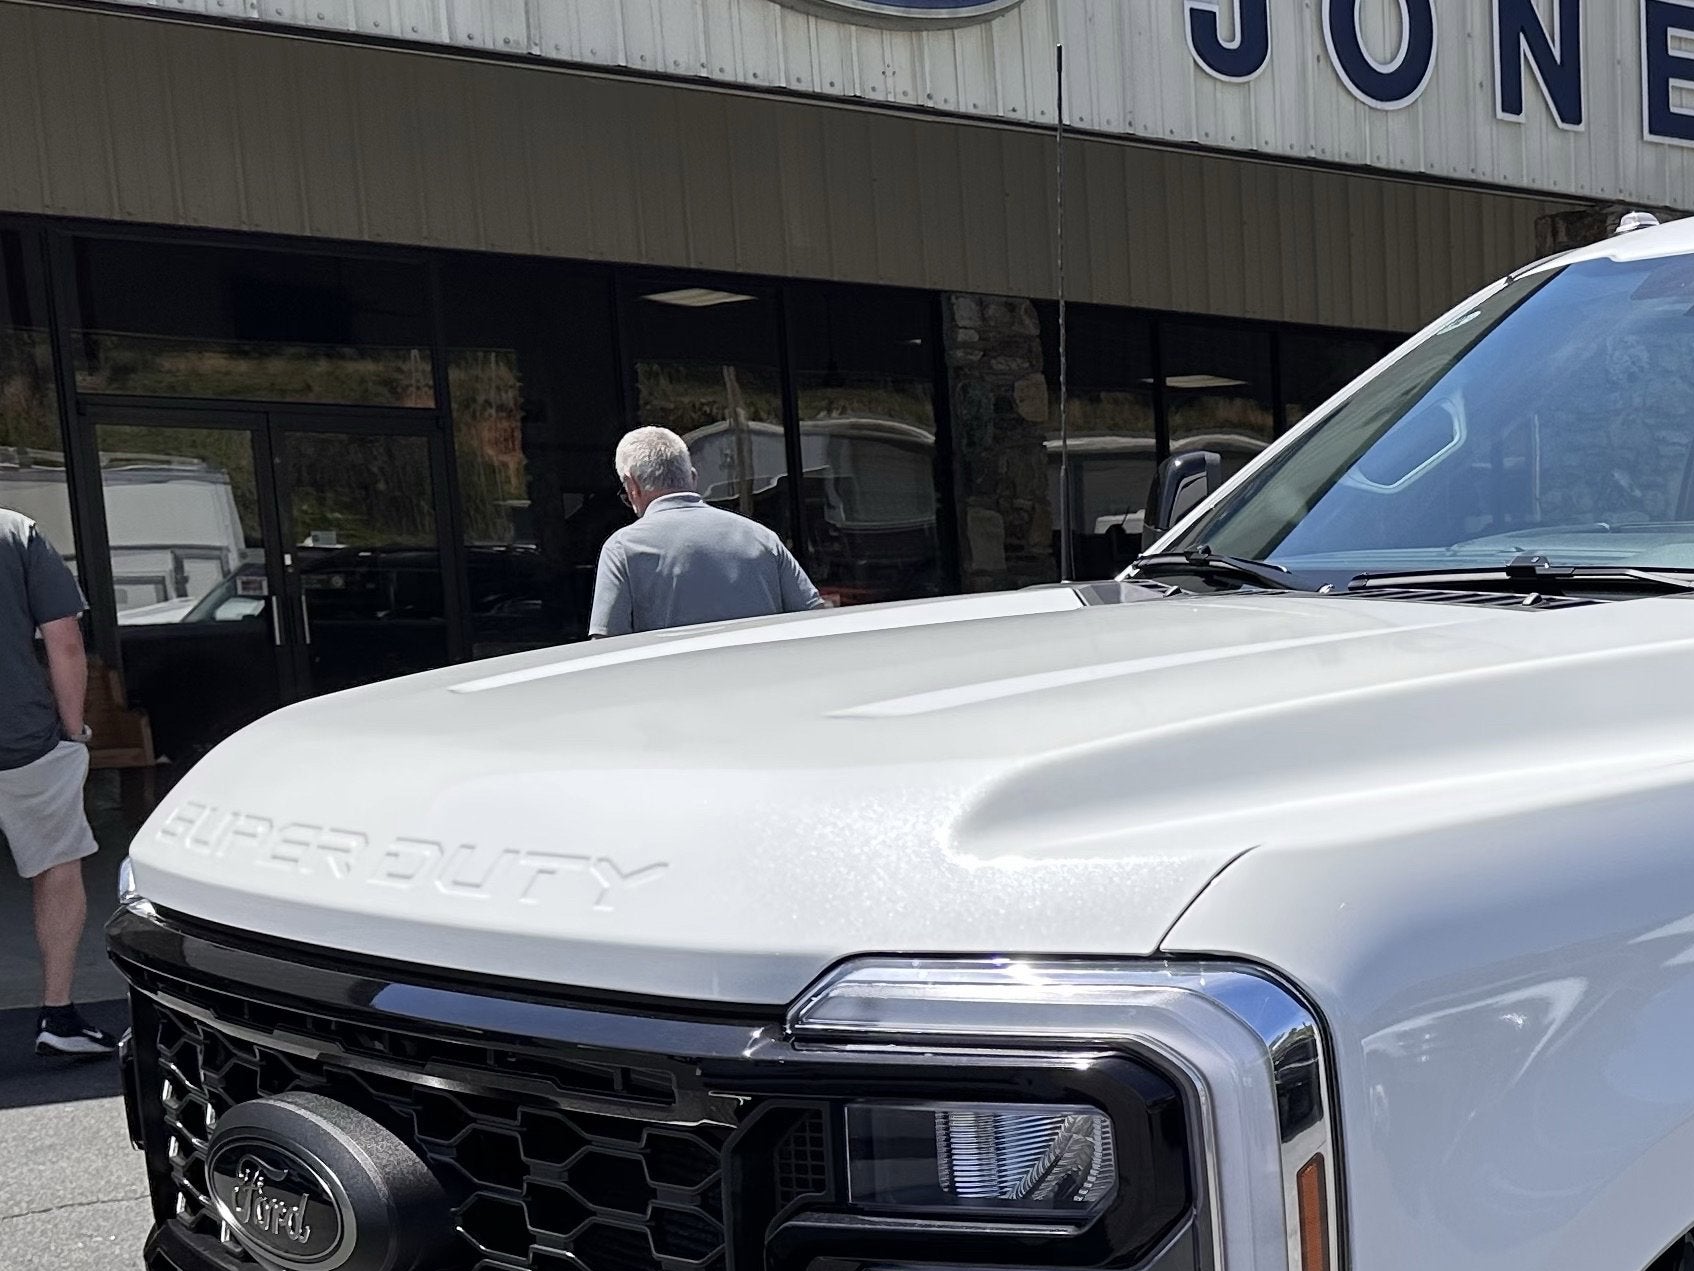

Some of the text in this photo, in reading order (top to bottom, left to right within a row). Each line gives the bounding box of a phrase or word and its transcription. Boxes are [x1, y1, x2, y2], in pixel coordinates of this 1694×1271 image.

[158, 800, 670, 912] SUPER DUTY
[232, 1153, 311, 1244] Ford
